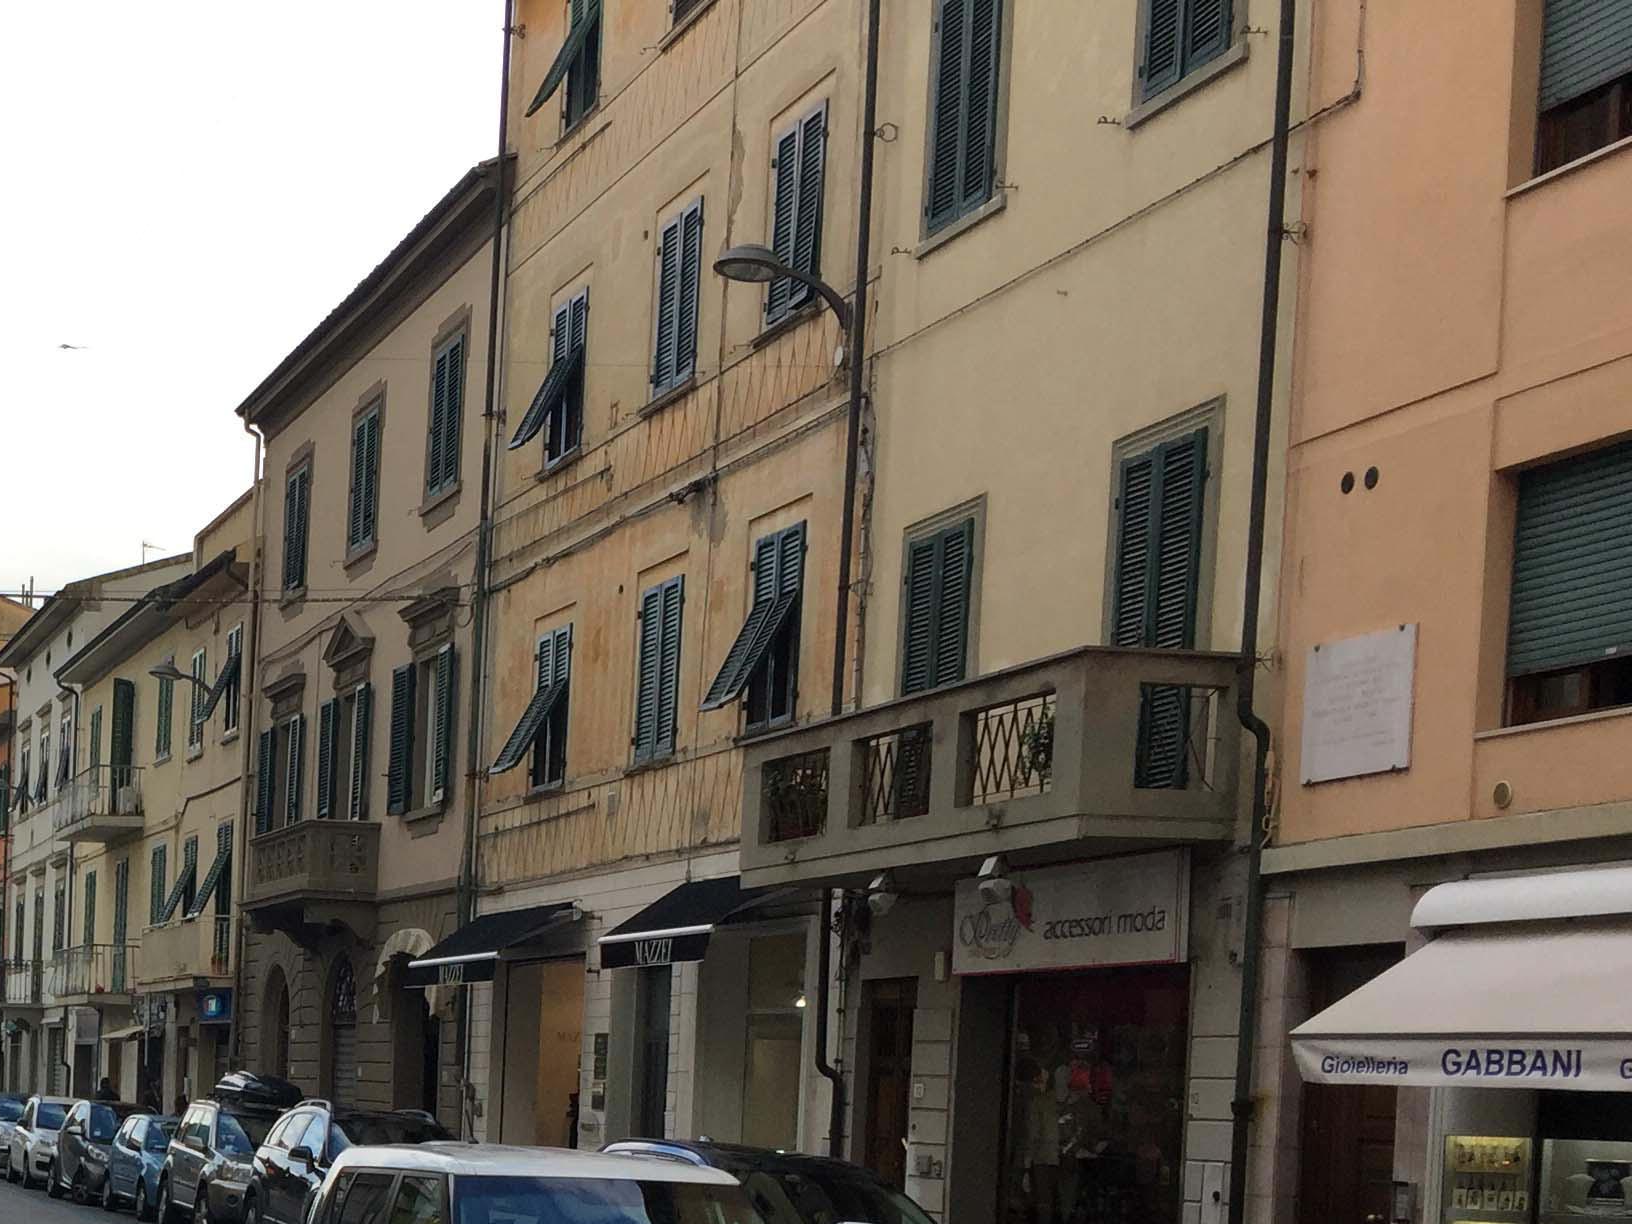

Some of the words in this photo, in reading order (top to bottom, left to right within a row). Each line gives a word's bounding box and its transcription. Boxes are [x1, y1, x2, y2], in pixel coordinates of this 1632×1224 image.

[1043, 910, 1112, 940] accessori
[1118, 905, 1167, 934] moda
[635, 938, 673, 965] MAZZEI
[1321, 1055, 1409, 1075] Gioielleria
[1441, 1049, 1582, 1078] GABBANI
